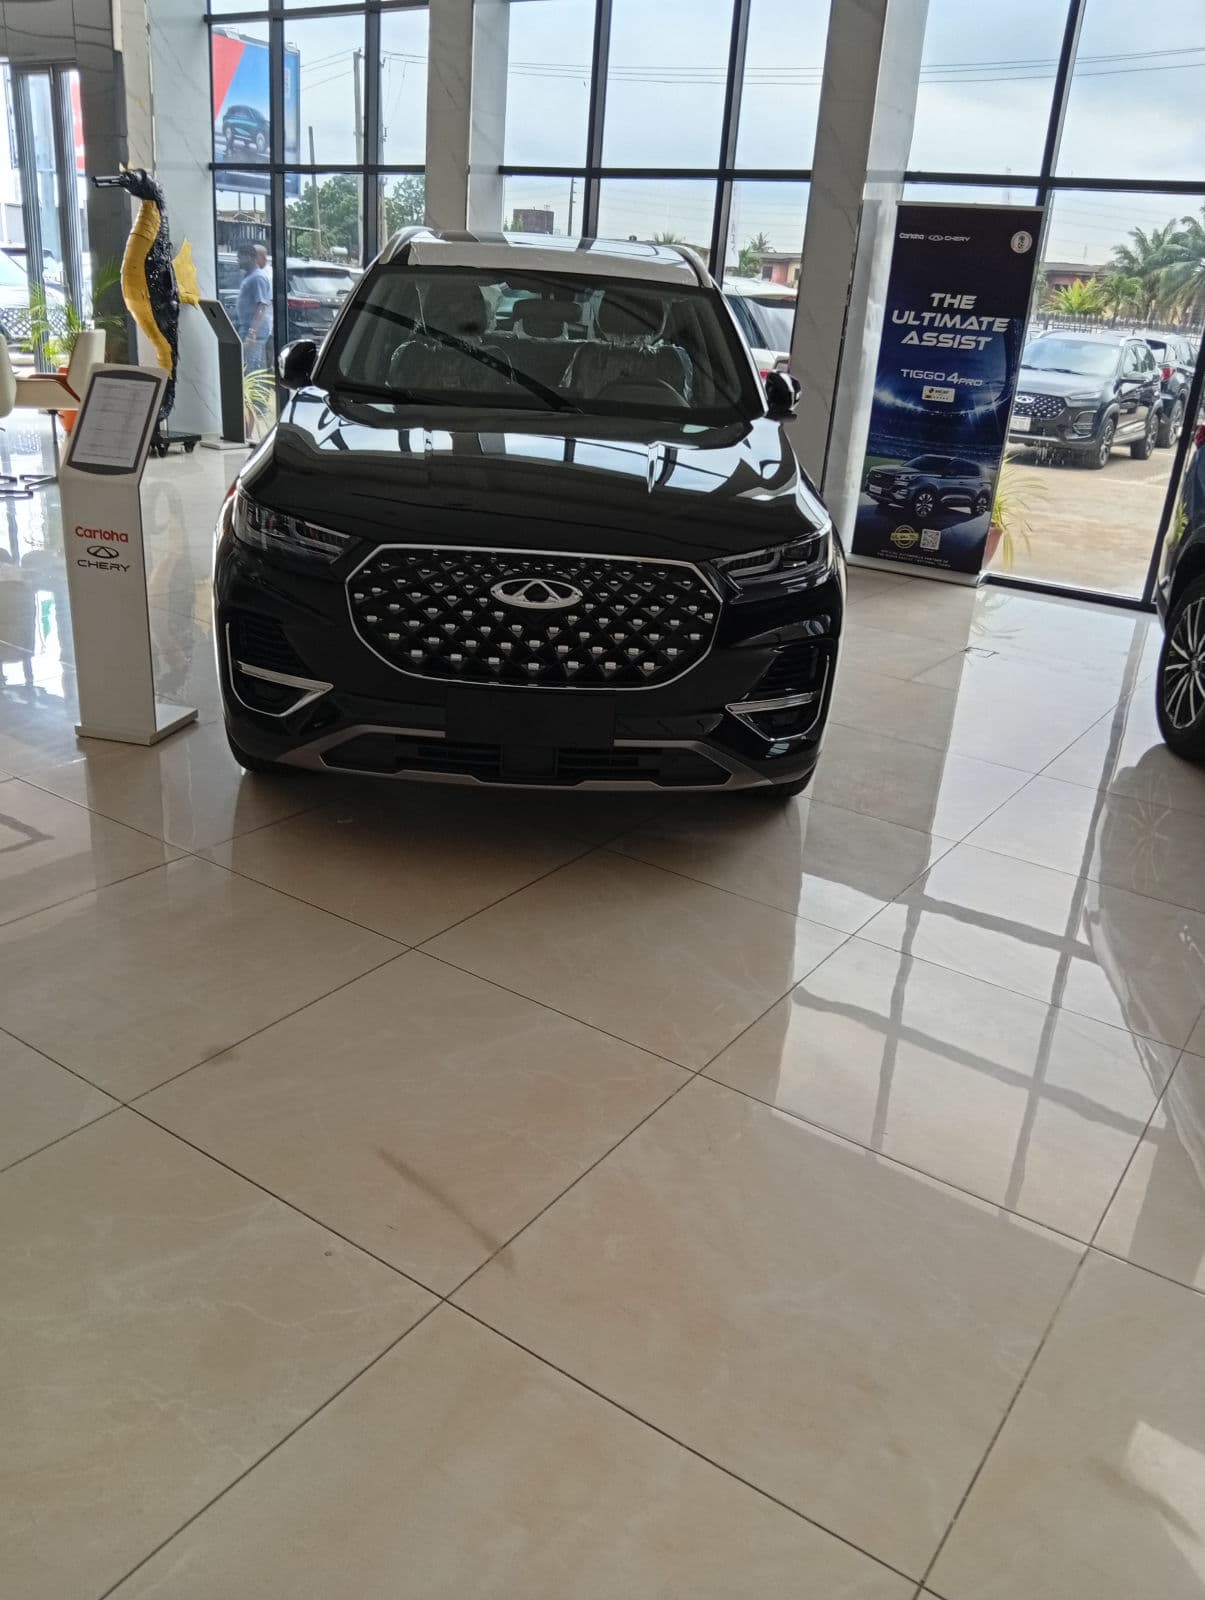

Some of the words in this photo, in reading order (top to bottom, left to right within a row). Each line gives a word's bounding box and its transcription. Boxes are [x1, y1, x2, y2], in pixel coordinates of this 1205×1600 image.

[930, 292, 977, 310] THE
[892, 310, 1011, 332] ULTIMATE
[900, 330, 993, 351] ASSIST
[900, 369, 946, 381] TIGGO
[77, 559, 131, 573] CHERY
